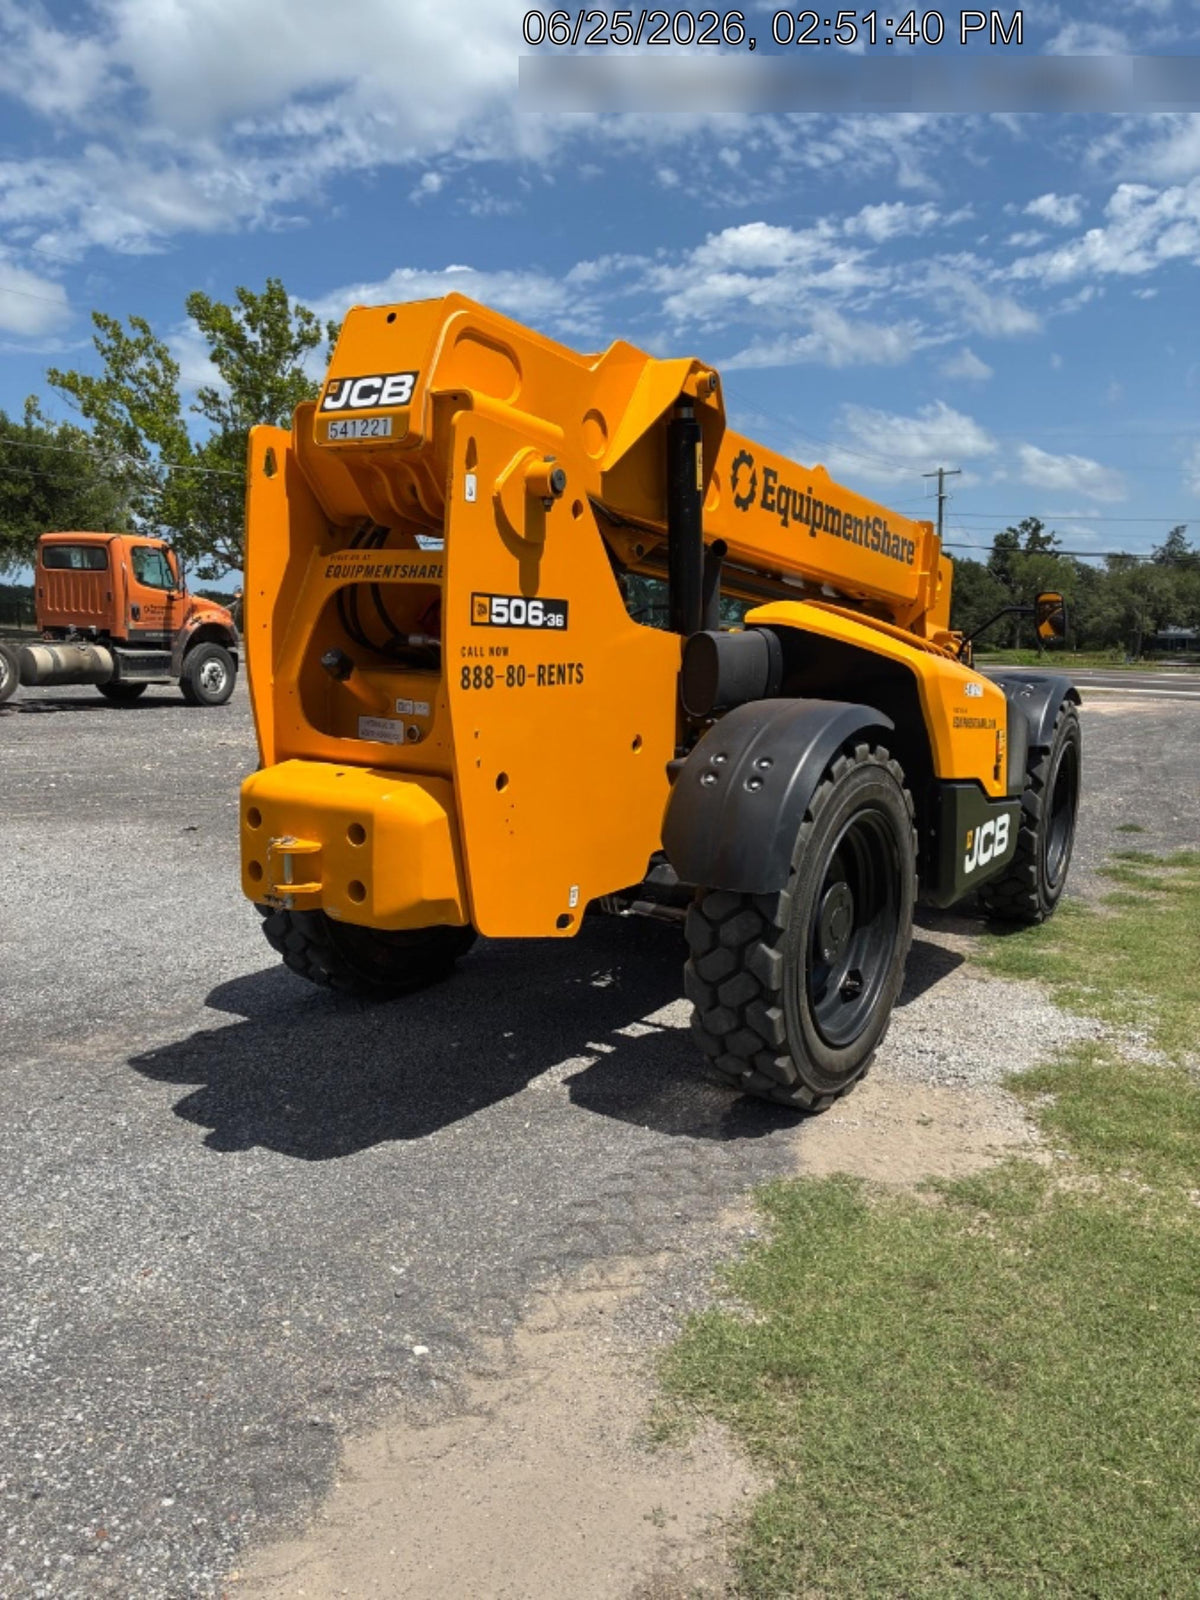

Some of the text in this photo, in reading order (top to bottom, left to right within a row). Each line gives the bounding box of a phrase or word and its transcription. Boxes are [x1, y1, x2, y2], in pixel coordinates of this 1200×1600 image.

[323, 374, 414, 410] JCB
[329, 419, 390, 439] 541221
[760, 466, 915, 566] EquipmentShare
[491, 597, 564, 627] 506-36
[460, 646, 509, 658] CALL NOW
[460, 662, 584, 691] 888-80-RENTS
[964, 812, 1010, 874] JCB
